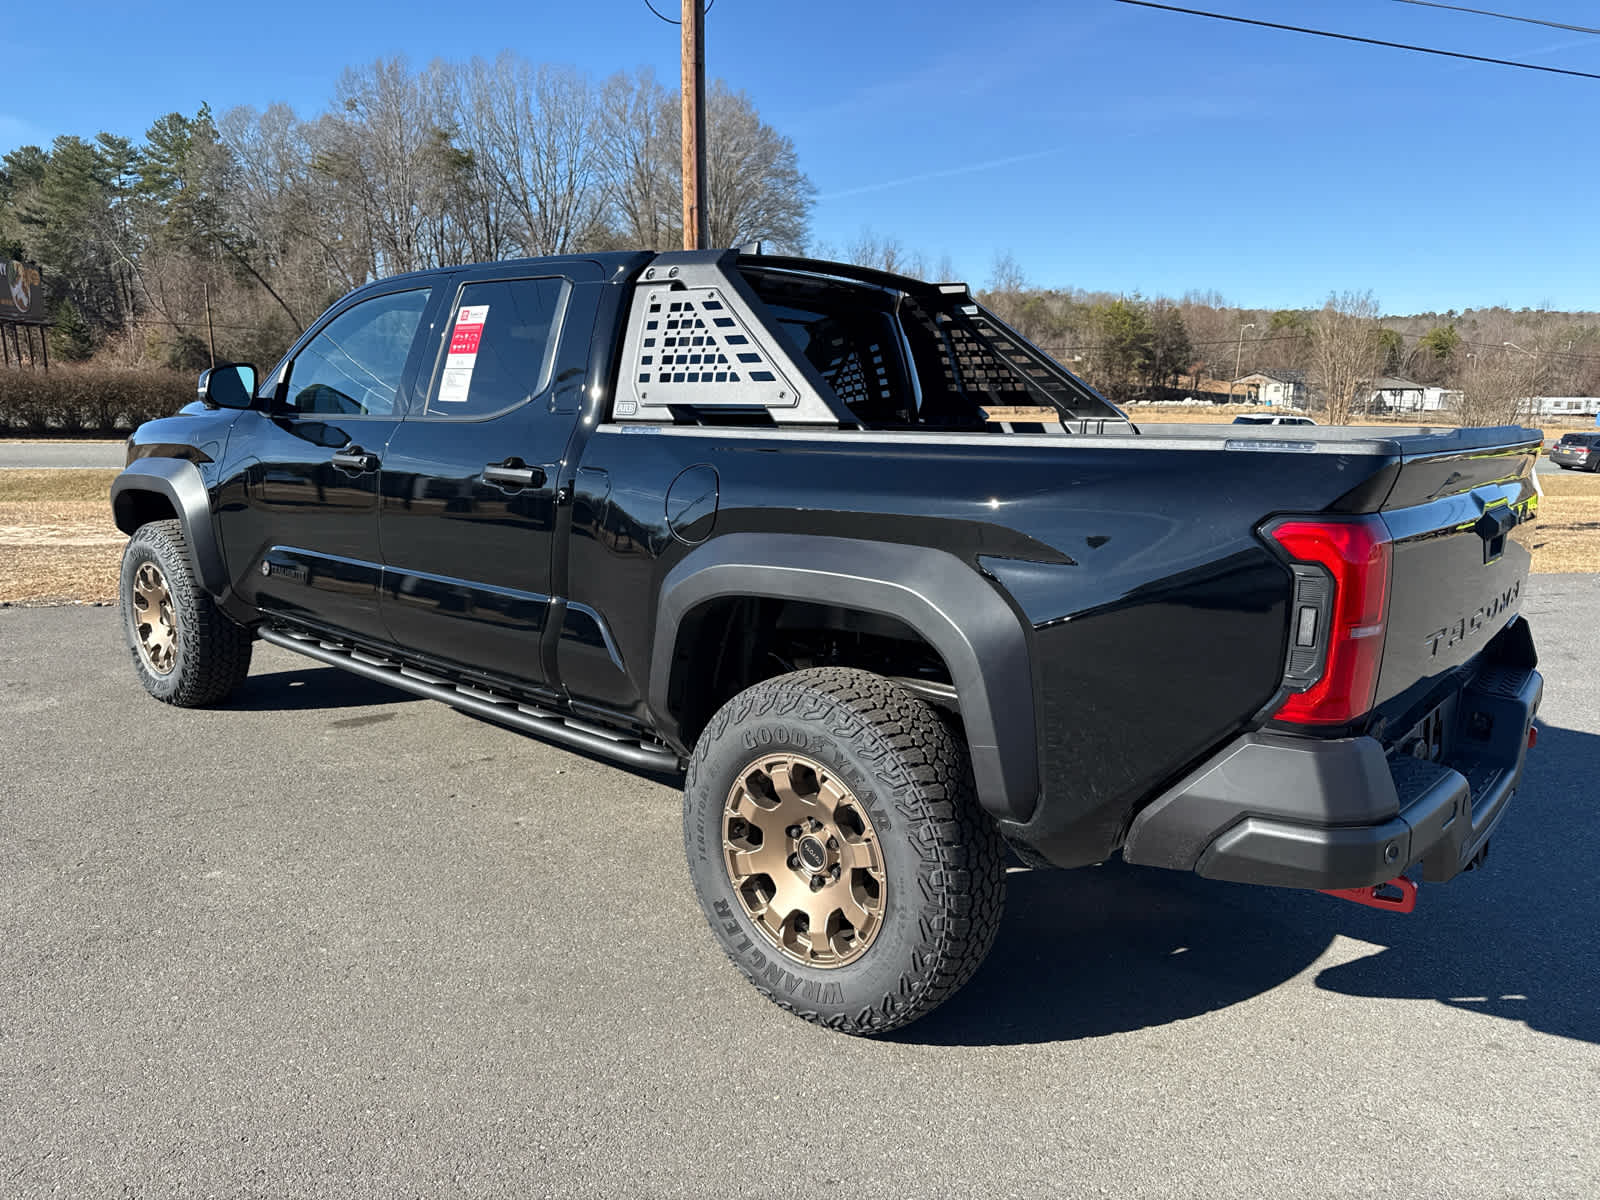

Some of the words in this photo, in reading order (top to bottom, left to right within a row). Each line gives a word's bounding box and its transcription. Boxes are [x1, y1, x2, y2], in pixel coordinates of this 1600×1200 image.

[616, 403, 636, 414] ARB
[1424, 580, 1520, 657] TACOMA
[743, 726, 891, 832] GOODYEAR
[713, 898, 845, 1005] WRANGLER
